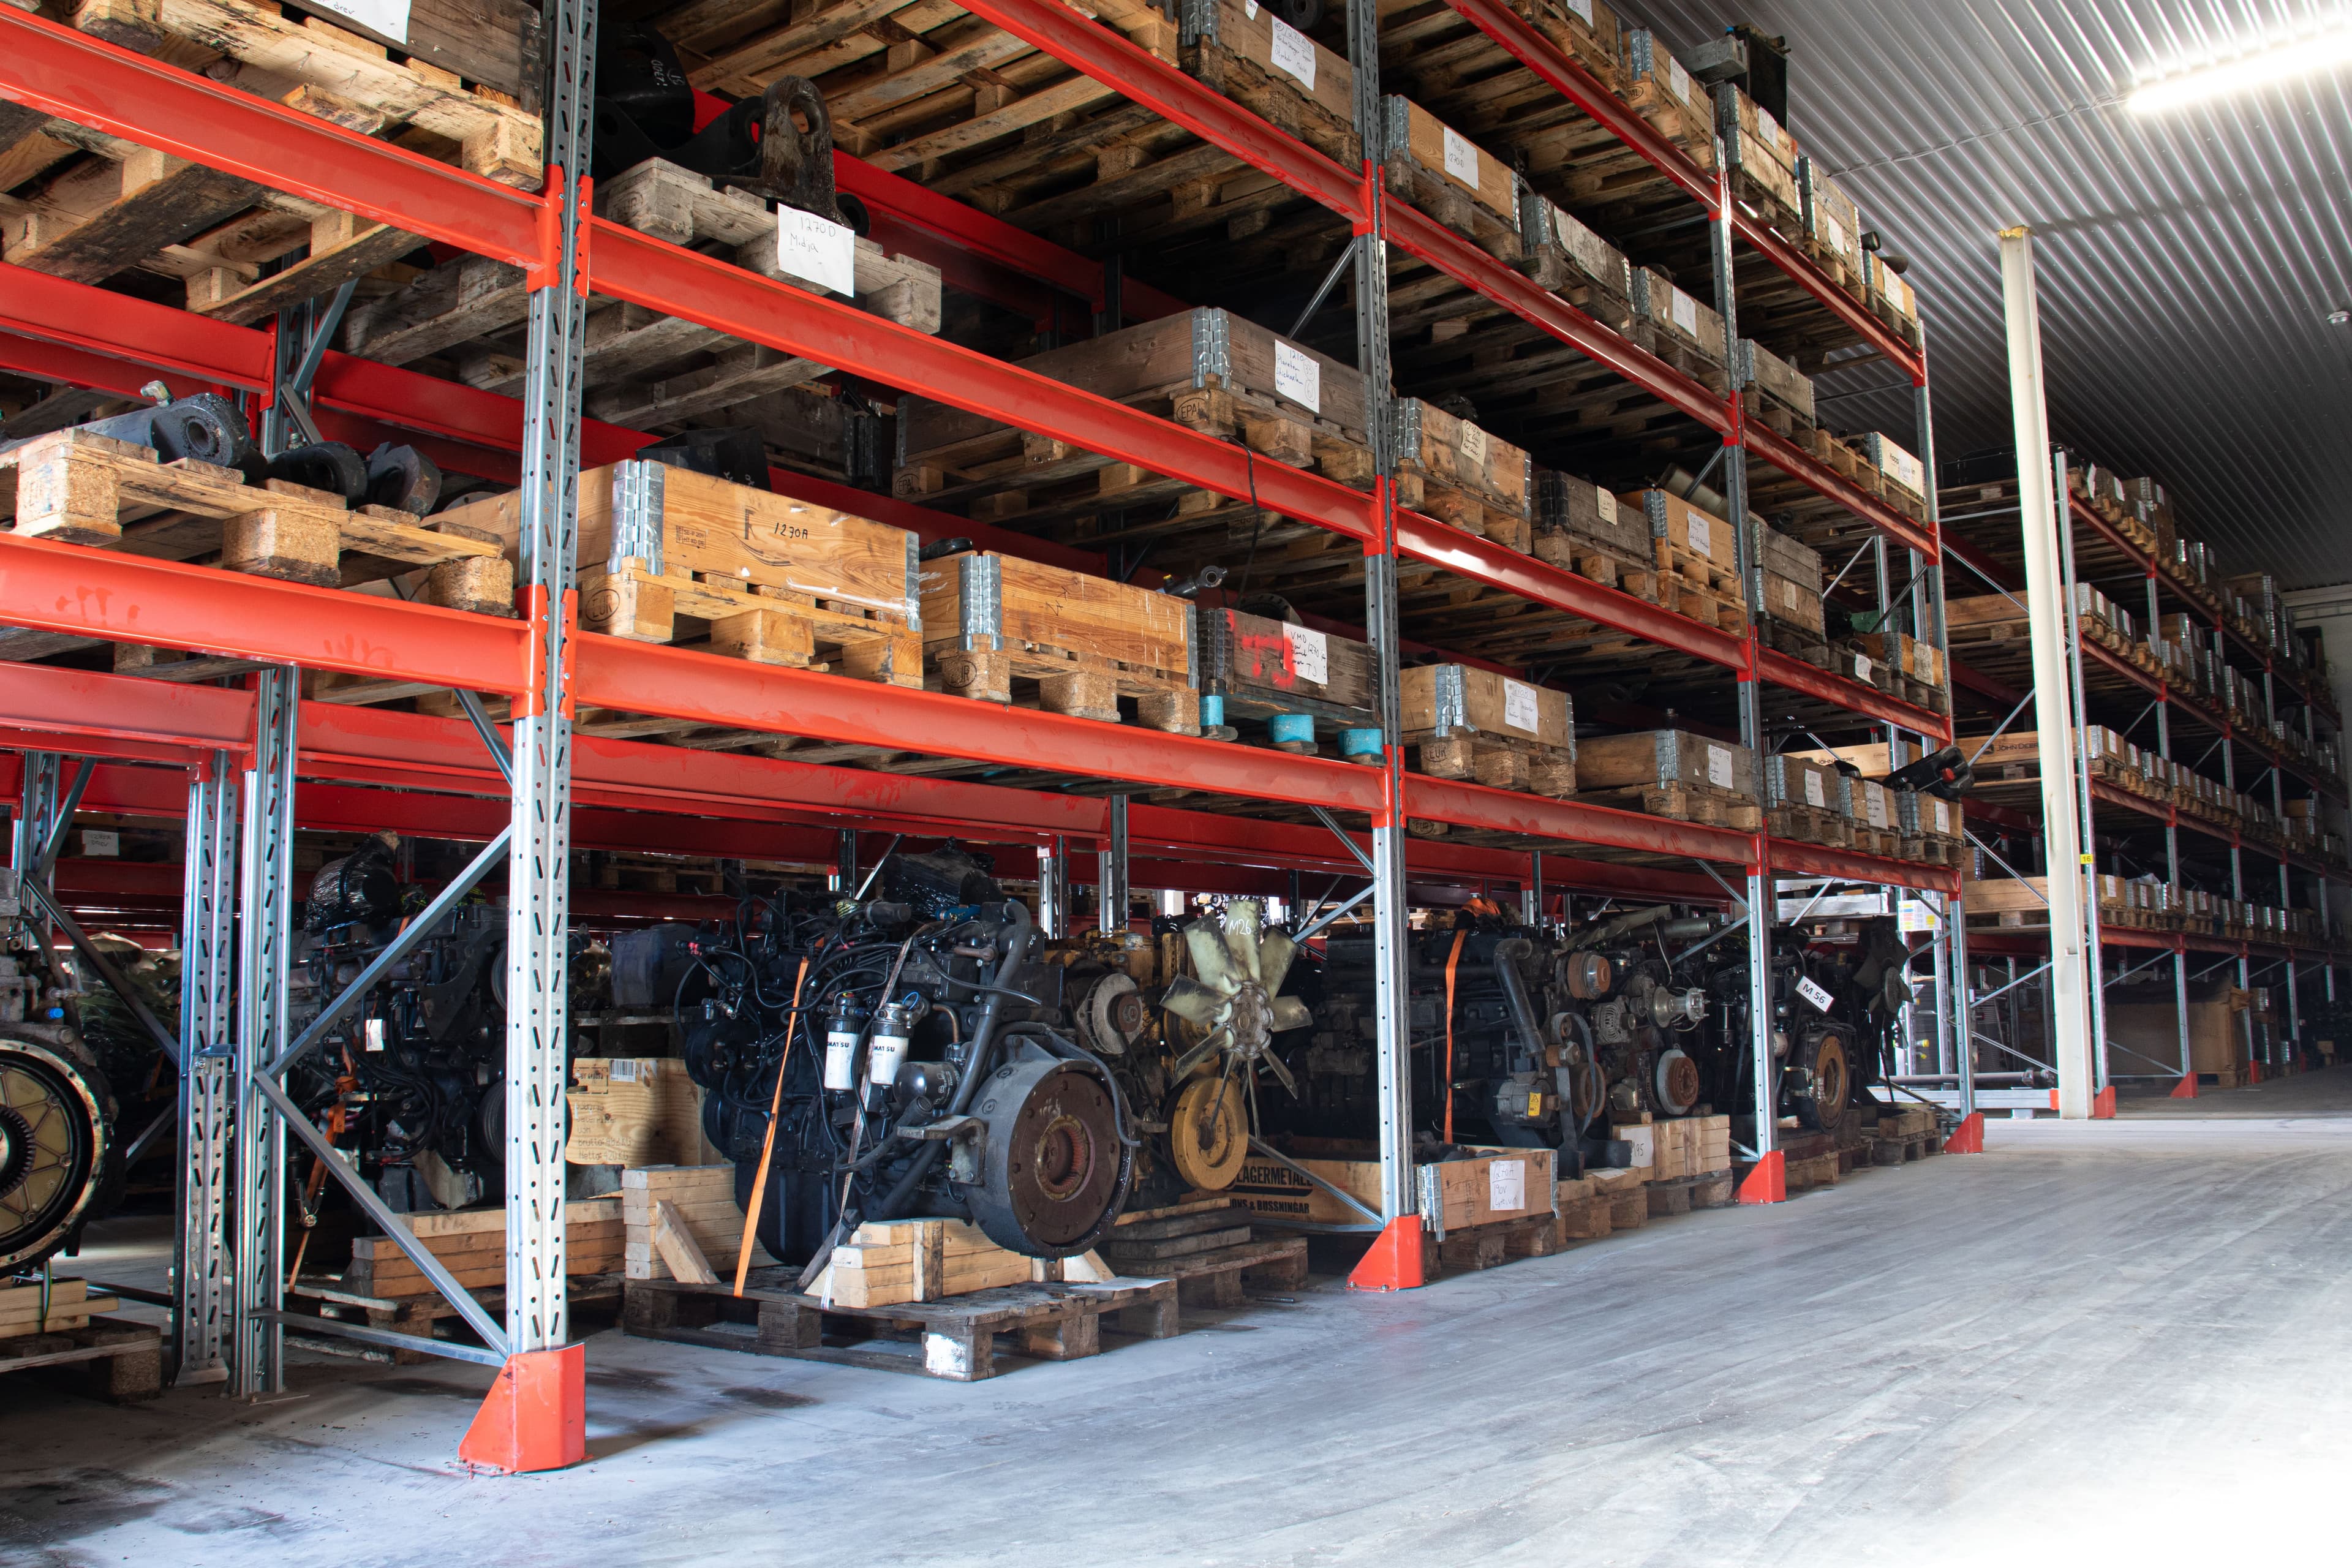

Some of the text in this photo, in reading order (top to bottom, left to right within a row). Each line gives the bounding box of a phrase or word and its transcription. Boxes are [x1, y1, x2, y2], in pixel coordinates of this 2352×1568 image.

[800, 217, 836, 238] 1270D
[790, 233, 819, 253] Midja
[592, 594, 613, 619] EUR
[1228, 919, 1251, 936] M26
[1802, 983, 1826, 1004] M 56
[1249, 1201, 1256, 1210] &
[1257, 1199, 1310, 1214] BUSSNINGAR
